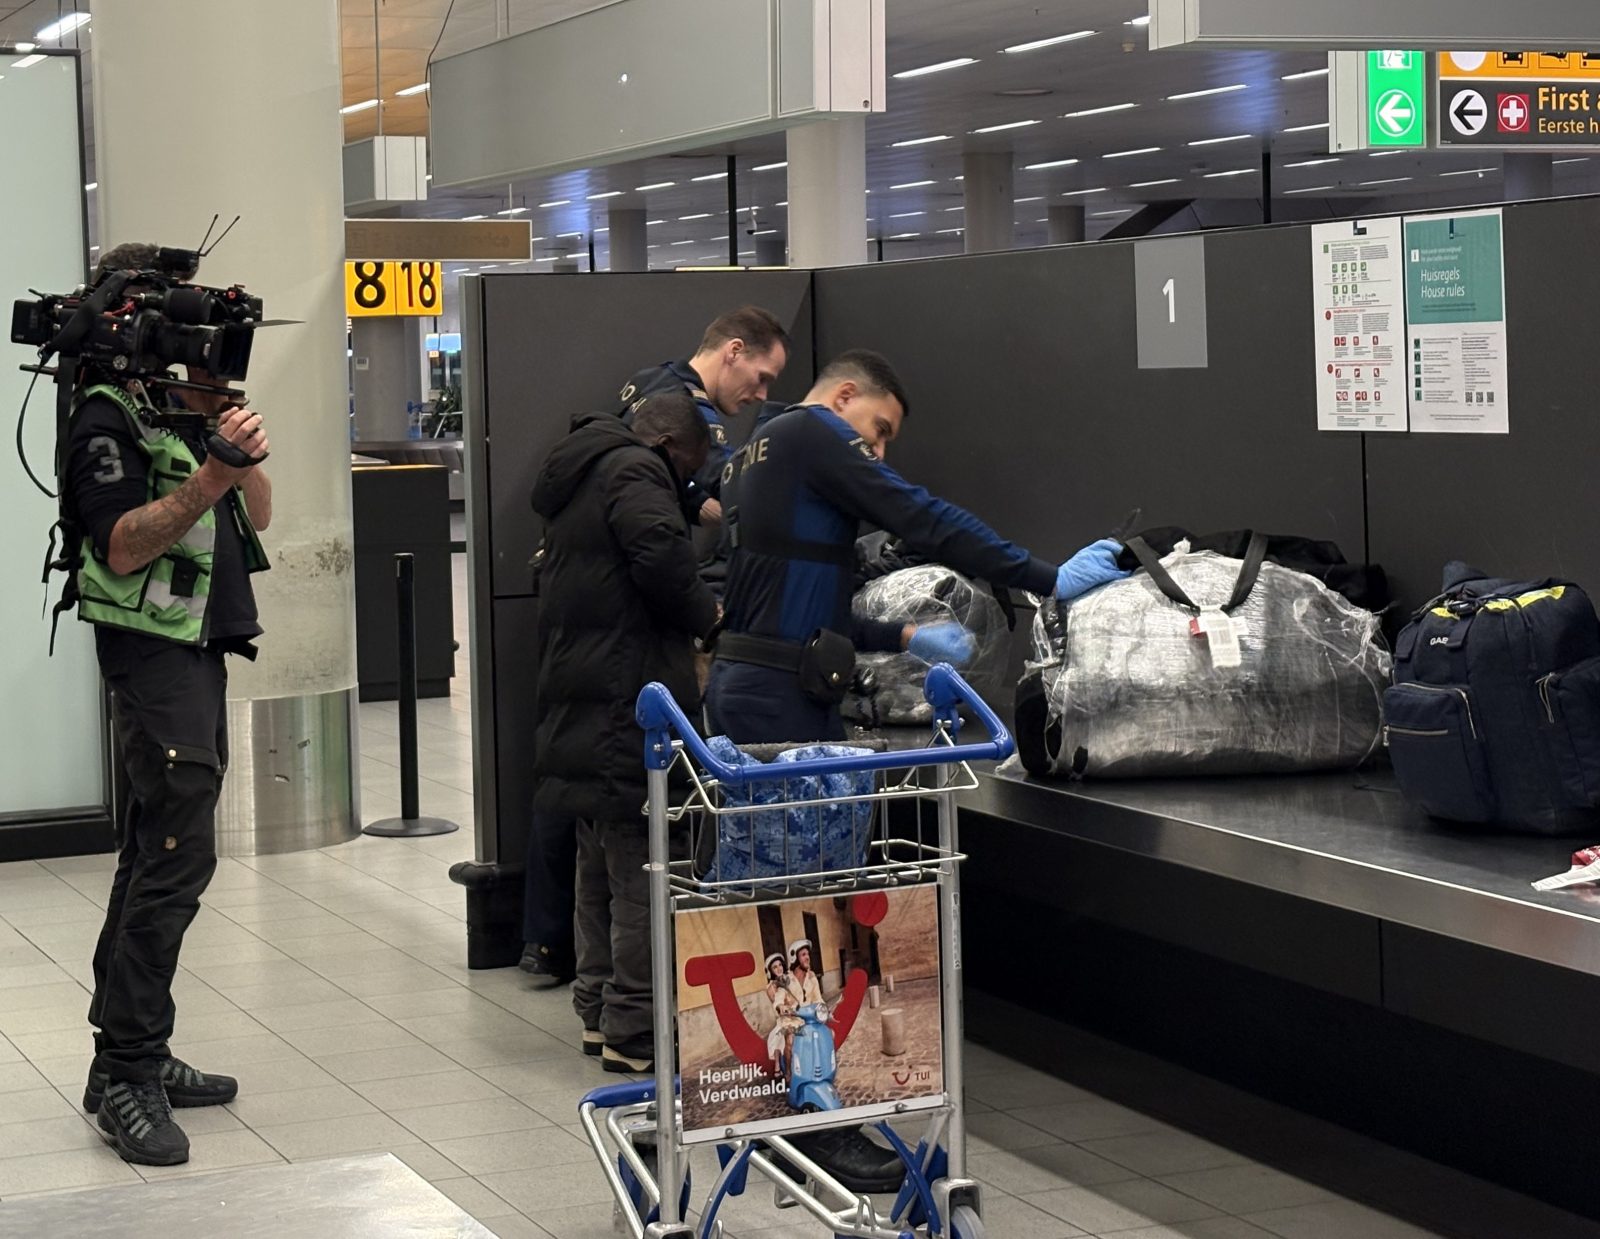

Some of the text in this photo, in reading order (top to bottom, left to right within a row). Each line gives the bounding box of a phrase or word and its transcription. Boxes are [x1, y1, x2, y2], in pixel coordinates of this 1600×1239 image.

[1538, 86, 1590, 111] First
[1538, 117, 1585, 134] Eerste
[354, 261, 437, 309] 8 18
[1420, 266, 1460, 284] Huisregels
[1162, 278, 1175, 323] 1
[1421, 283, 1465, 298] House rules
[88, 436, 125, 484] 3
[699, 1062, 768, 1085] Heerlijk.
[914, 1070, 931, 1081] TUI
[699, 1078, 791, 1104] Verdwaald.
